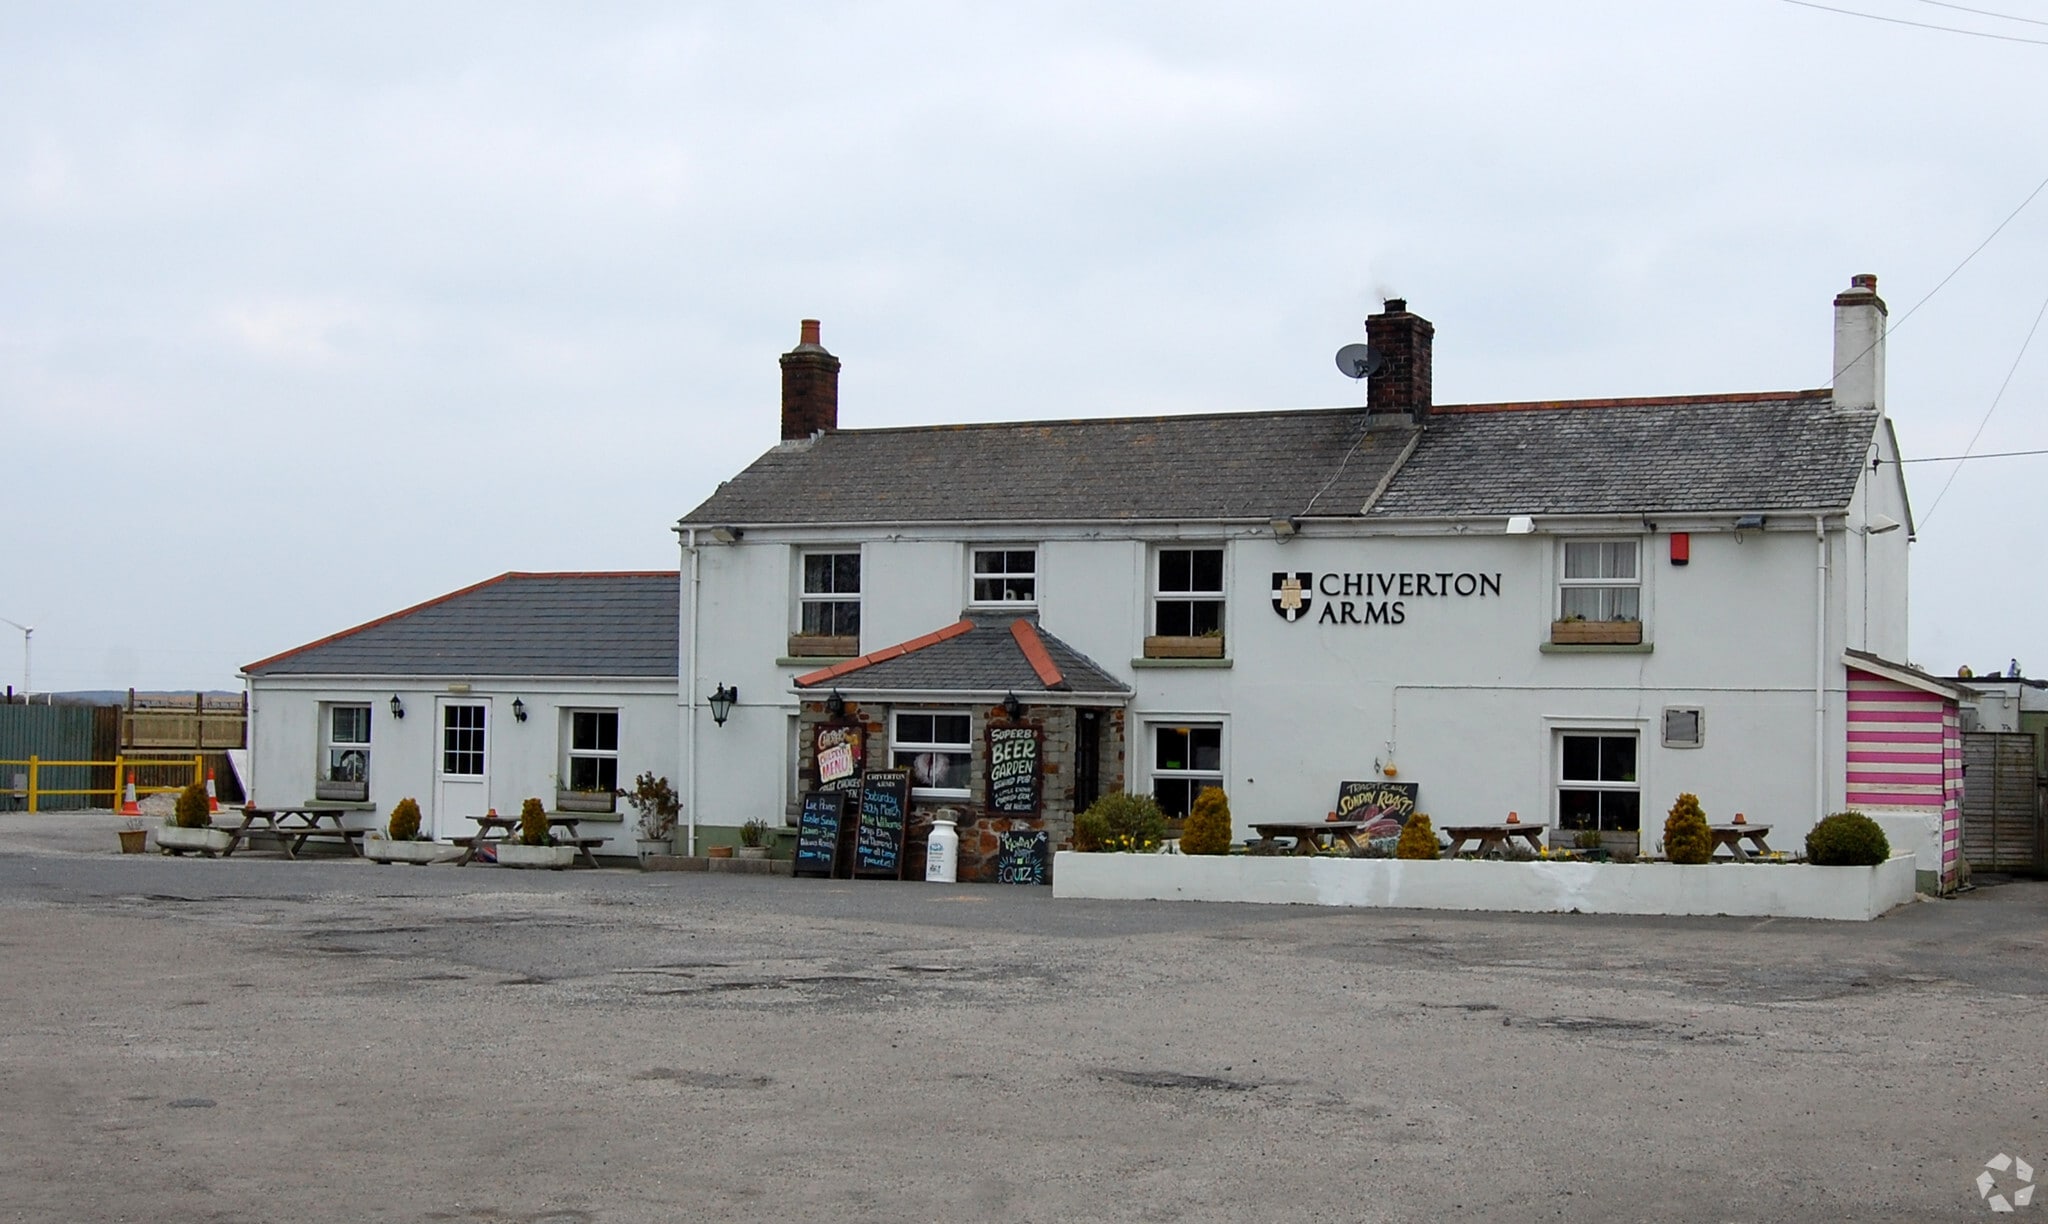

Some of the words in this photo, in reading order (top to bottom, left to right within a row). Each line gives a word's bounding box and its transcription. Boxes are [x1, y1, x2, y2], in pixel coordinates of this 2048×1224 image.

[1319, 573, 1502, 597] CHIVERTON
[1319, 601, 1406, 625] ARMS
[991, 728, 1032, 741] SUPERB
[992, 739, 1036, 765] BEER
[991, 760, 1033, 781] GARDEN
[863, 788, 897, 804] Saturday
[1347, 783, 1408, 795] TRADITIONAL
[880, 803, 901, 817] March
[1339, 791, 1376, 816] SUNDAY
[1377, 791, 1413, 816] ROAST!
[876, 815, 902, 830] Williams
[1003, 866, 1032, 884] QUIZ
